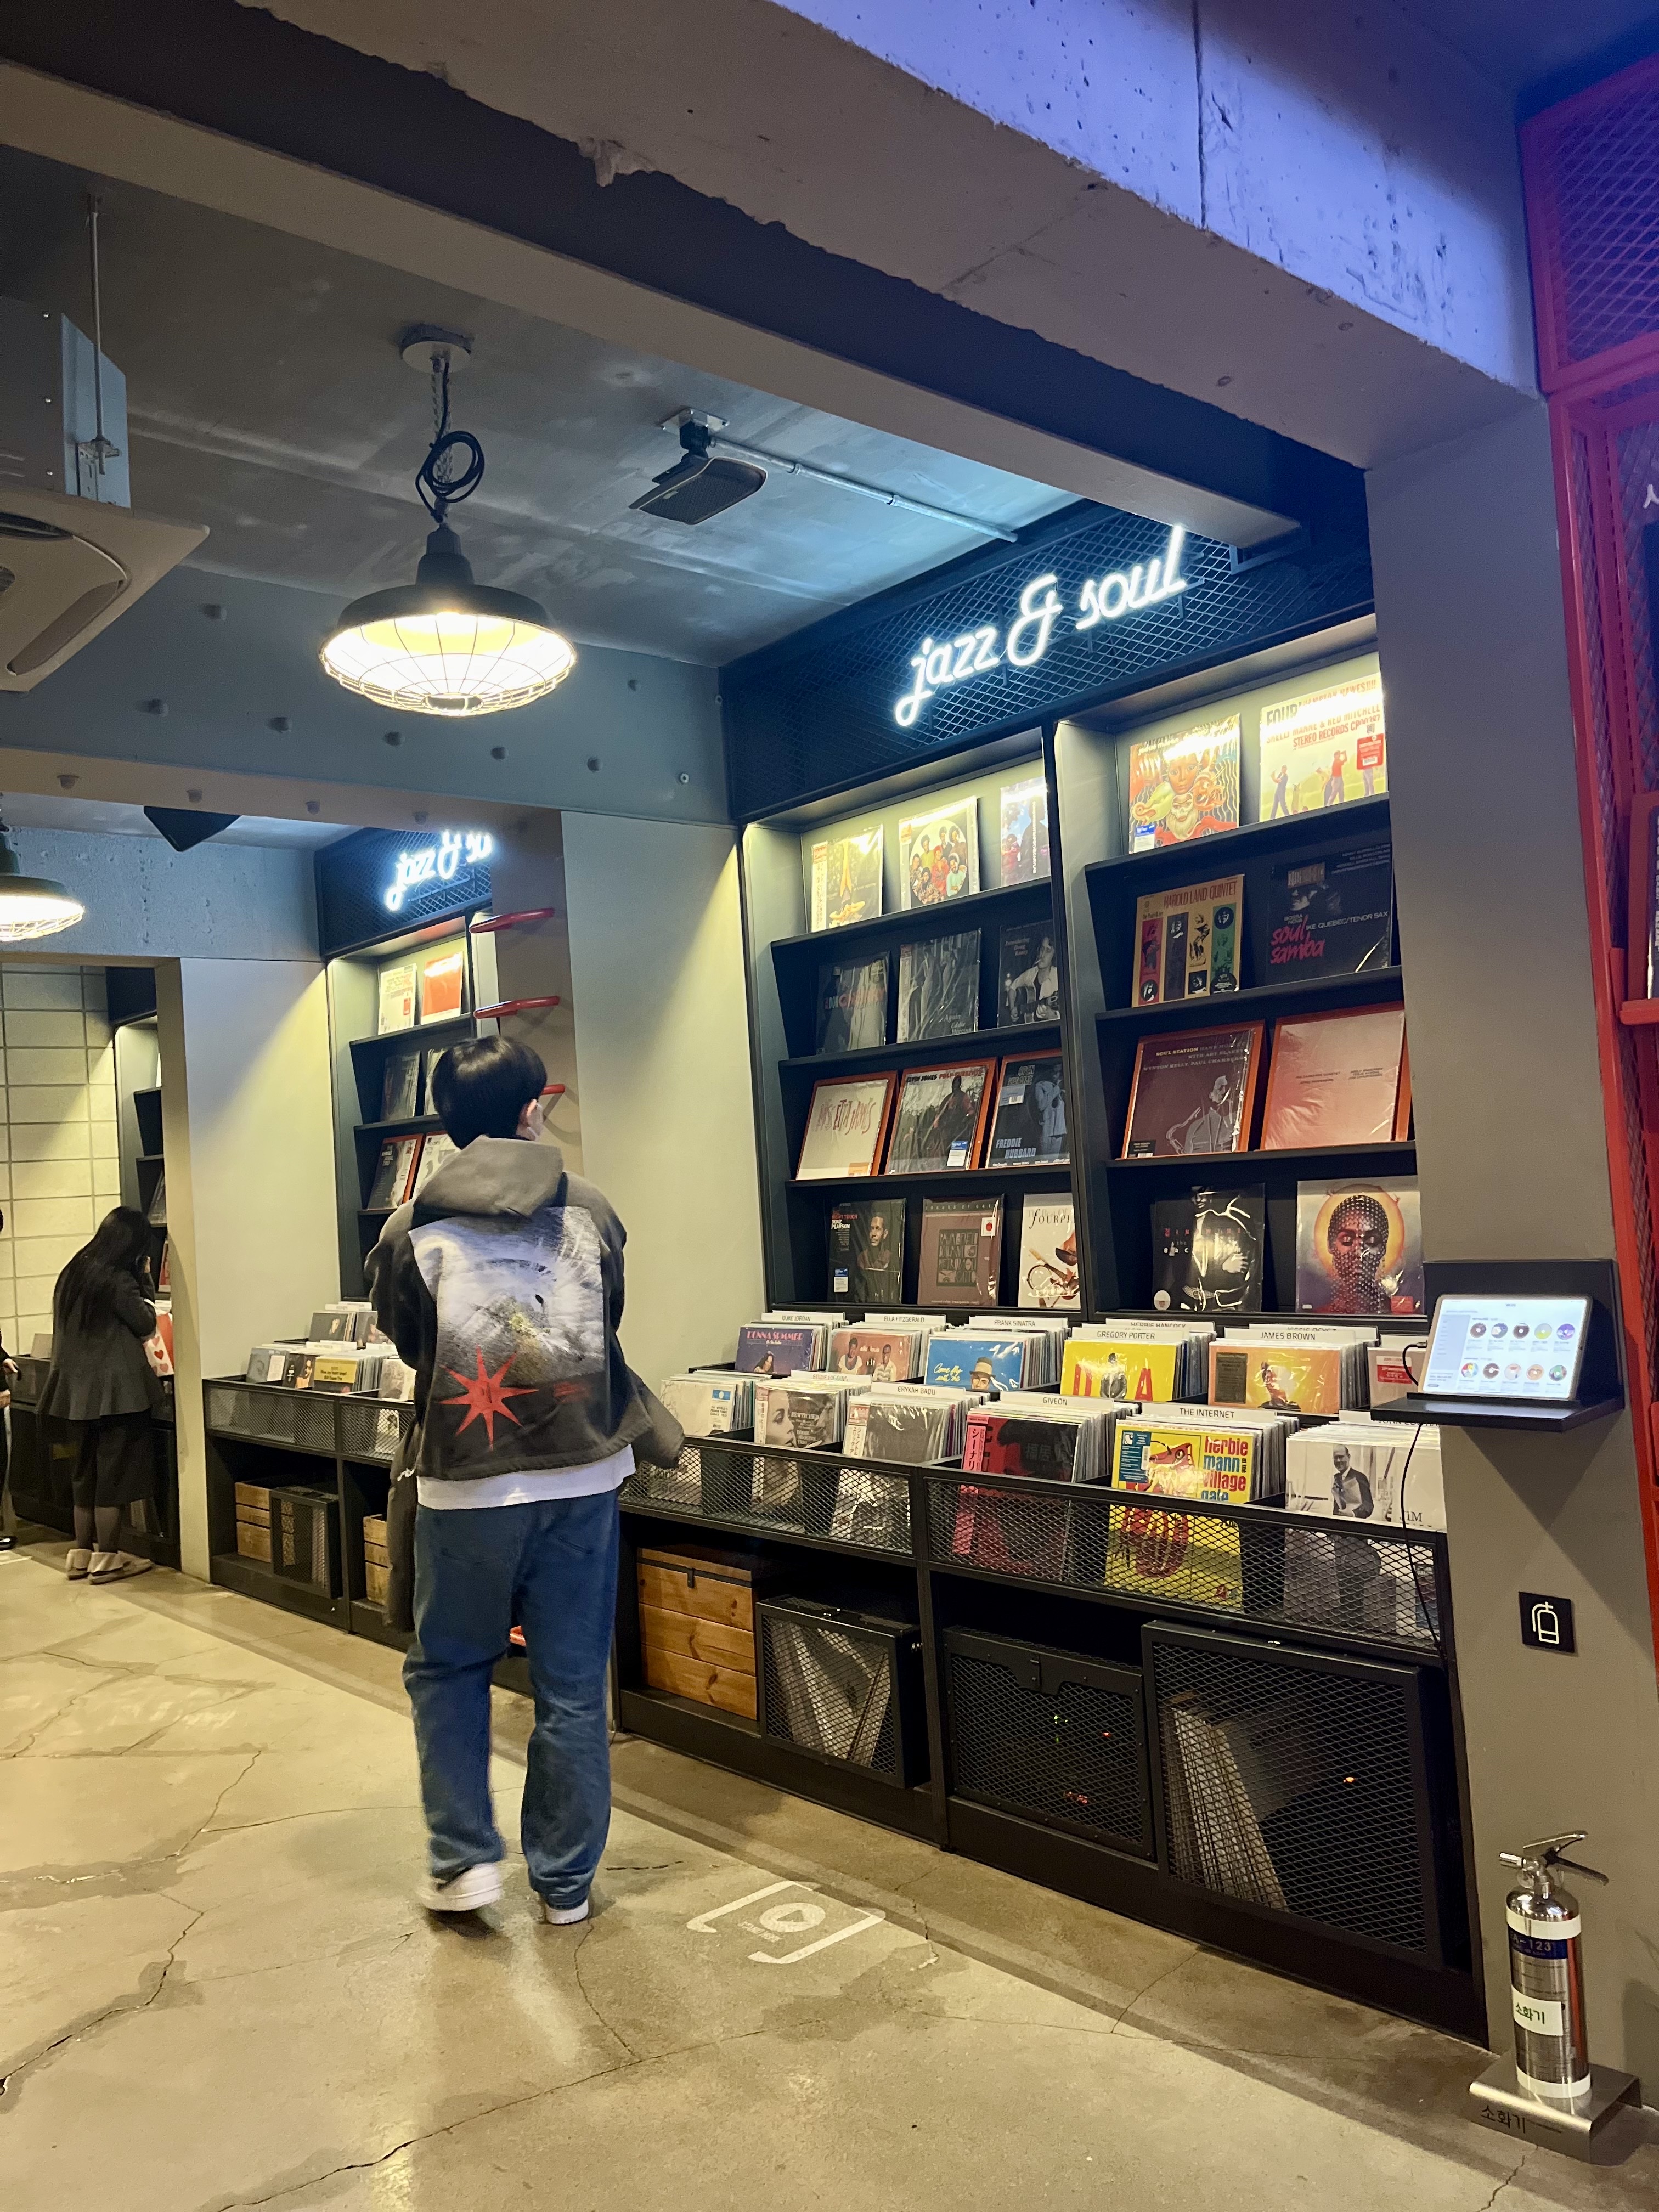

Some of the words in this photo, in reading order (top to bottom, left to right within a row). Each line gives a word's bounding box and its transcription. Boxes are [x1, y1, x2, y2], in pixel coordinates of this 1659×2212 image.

[895, 626, 1000, 726] jazz
[1007, 573, 1063, 666] &
[1076, 525, 1187, 630] soul
[1293, 732, 1317, 747] STEREO
[1318, 723, 1349, 741] RECORDS
[386, 850, 436, 911] jazz
[1164, 891, 1188, 909] HAROLD
[1190, 888, 1207, 904] LAND
[1209, 880, 1238, 900] QUINTET
[1373, 911, 1388, 919] SAX
[1271, 914, 1309, 946] soul
[1270, 931, 1325, 964] samba
[996, 1138, 1022, 1149] FREDDIE
[1005, 1148, 1036, 1159] HUBBARD
[747, 1331, 771, 1339] DONNA
[772, 1332, 804, 1341] SUMMER
[1043, 1397, 1067, 1406] GIVEON
[791, 1412, 820, 1420] BEWITCHED
[1180, 1408, 1194, 1416] THE
[1197, 1409, 1235, 1418] INTERNET
[1205, 1436, 1248, 1457] herbie
[1203, 1455, 1240, 1473] mann
[1203, 1471, 1246, 1492] village
[1515, 2002, 1545, 2024] 소화기
[1481, 2104, 1526, 2134] 소화기
